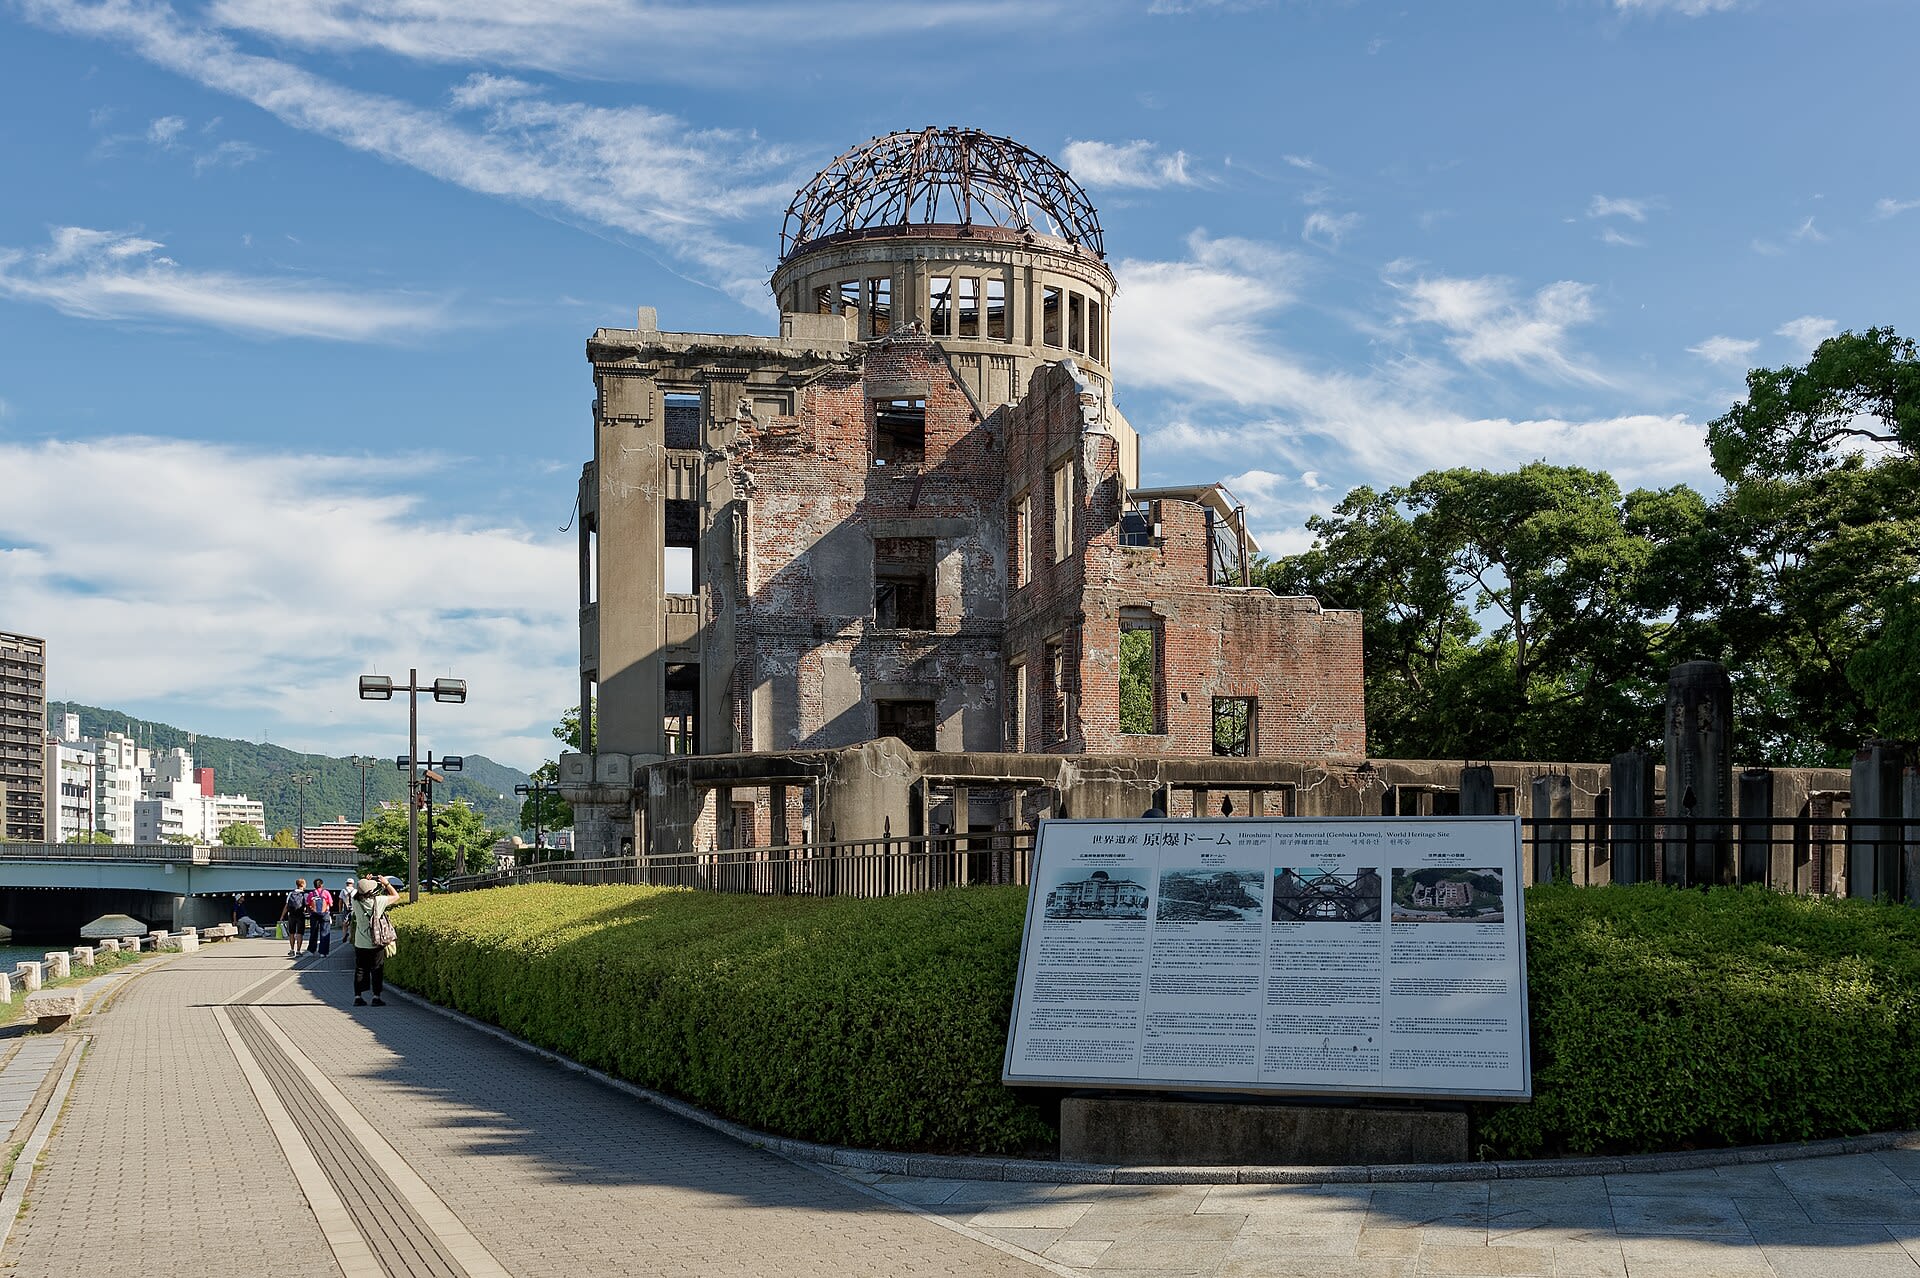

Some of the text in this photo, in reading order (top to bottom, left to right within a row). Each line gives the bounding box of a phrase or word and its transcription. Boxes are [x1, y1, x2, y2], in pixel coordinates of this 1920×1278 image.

[1092, 832, 1232, 847] 世界遺産 原爆ドーム
[1326, 831, 1357, 839] (Genbaku
[1409, 832, 1436, 840] Heritage
